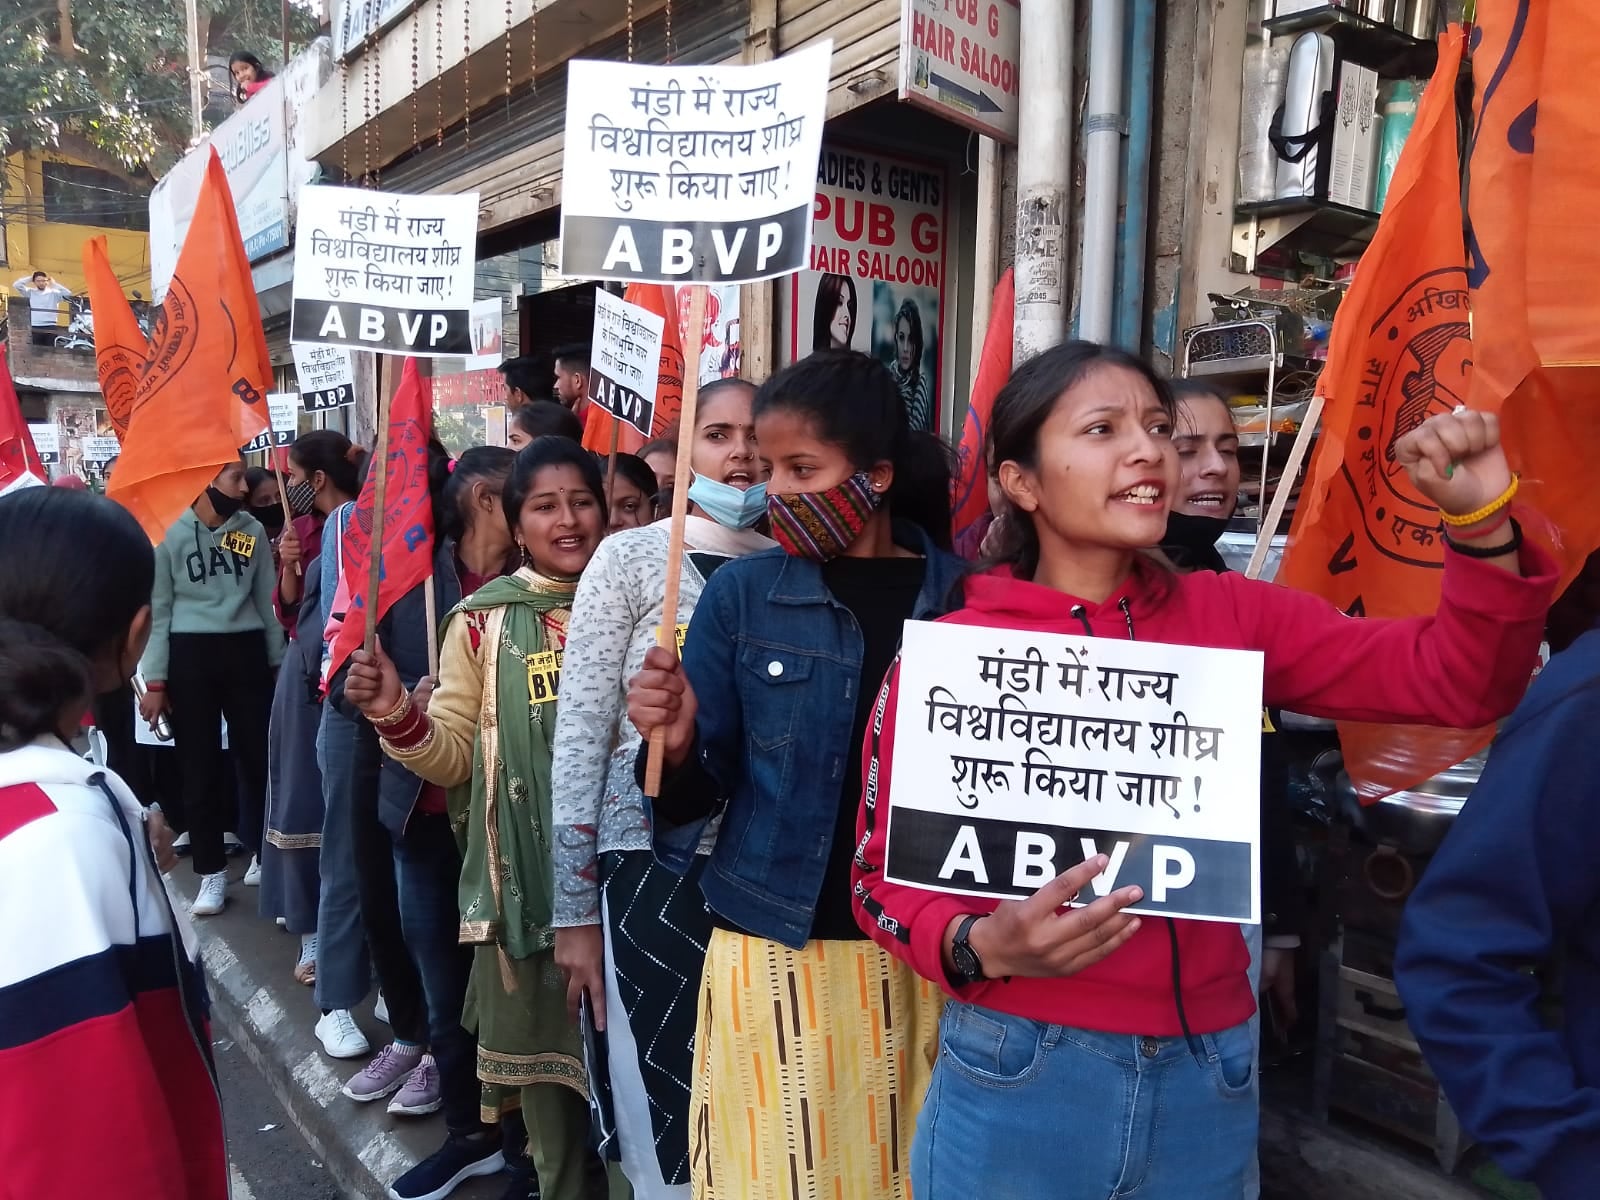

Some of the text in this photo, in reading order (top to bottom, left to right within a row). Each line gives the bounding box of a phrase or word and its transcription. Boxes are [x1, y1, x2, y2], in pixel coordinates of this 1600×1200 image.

[988, 4, 999, 38] G
[913, 10, 1018, 96] HAIR SALOON
[629, 77, 781, 117] मंडी में राज्य
[588, 112, 805, 157] विश्वविद्यालय शीघ्र
[610, 169, 660, 212] शुरू
[667, 160, 732, 200] किया
[816, 151, 939, 206] ADIES & GENTS
[338, 199, 445, 237] मंडी में राज्य
[812, 193, 939, 254] PUB G
[311, 228, 462, 267] विश्वविद्यालय शीघ्र
[857, 249, 939, 288] SALOON
[325, 267, 359, 297] शुरू
[364, 263, 413, 294] किया
[314, 386, 346, 408] ABP
[1392, 514, 1446, 546] एक
[531, 670, 560, 700] BV
[978, 645, 1179, 705] मंडी में राज्य
[925, 686, 1224, 761] विश्वविद्यालय शीघ्र
[865, 756, 878, 809] PUBG
[951, 754, 1014, 809] शुरू
[1022, 747, 1108, 802] किया
